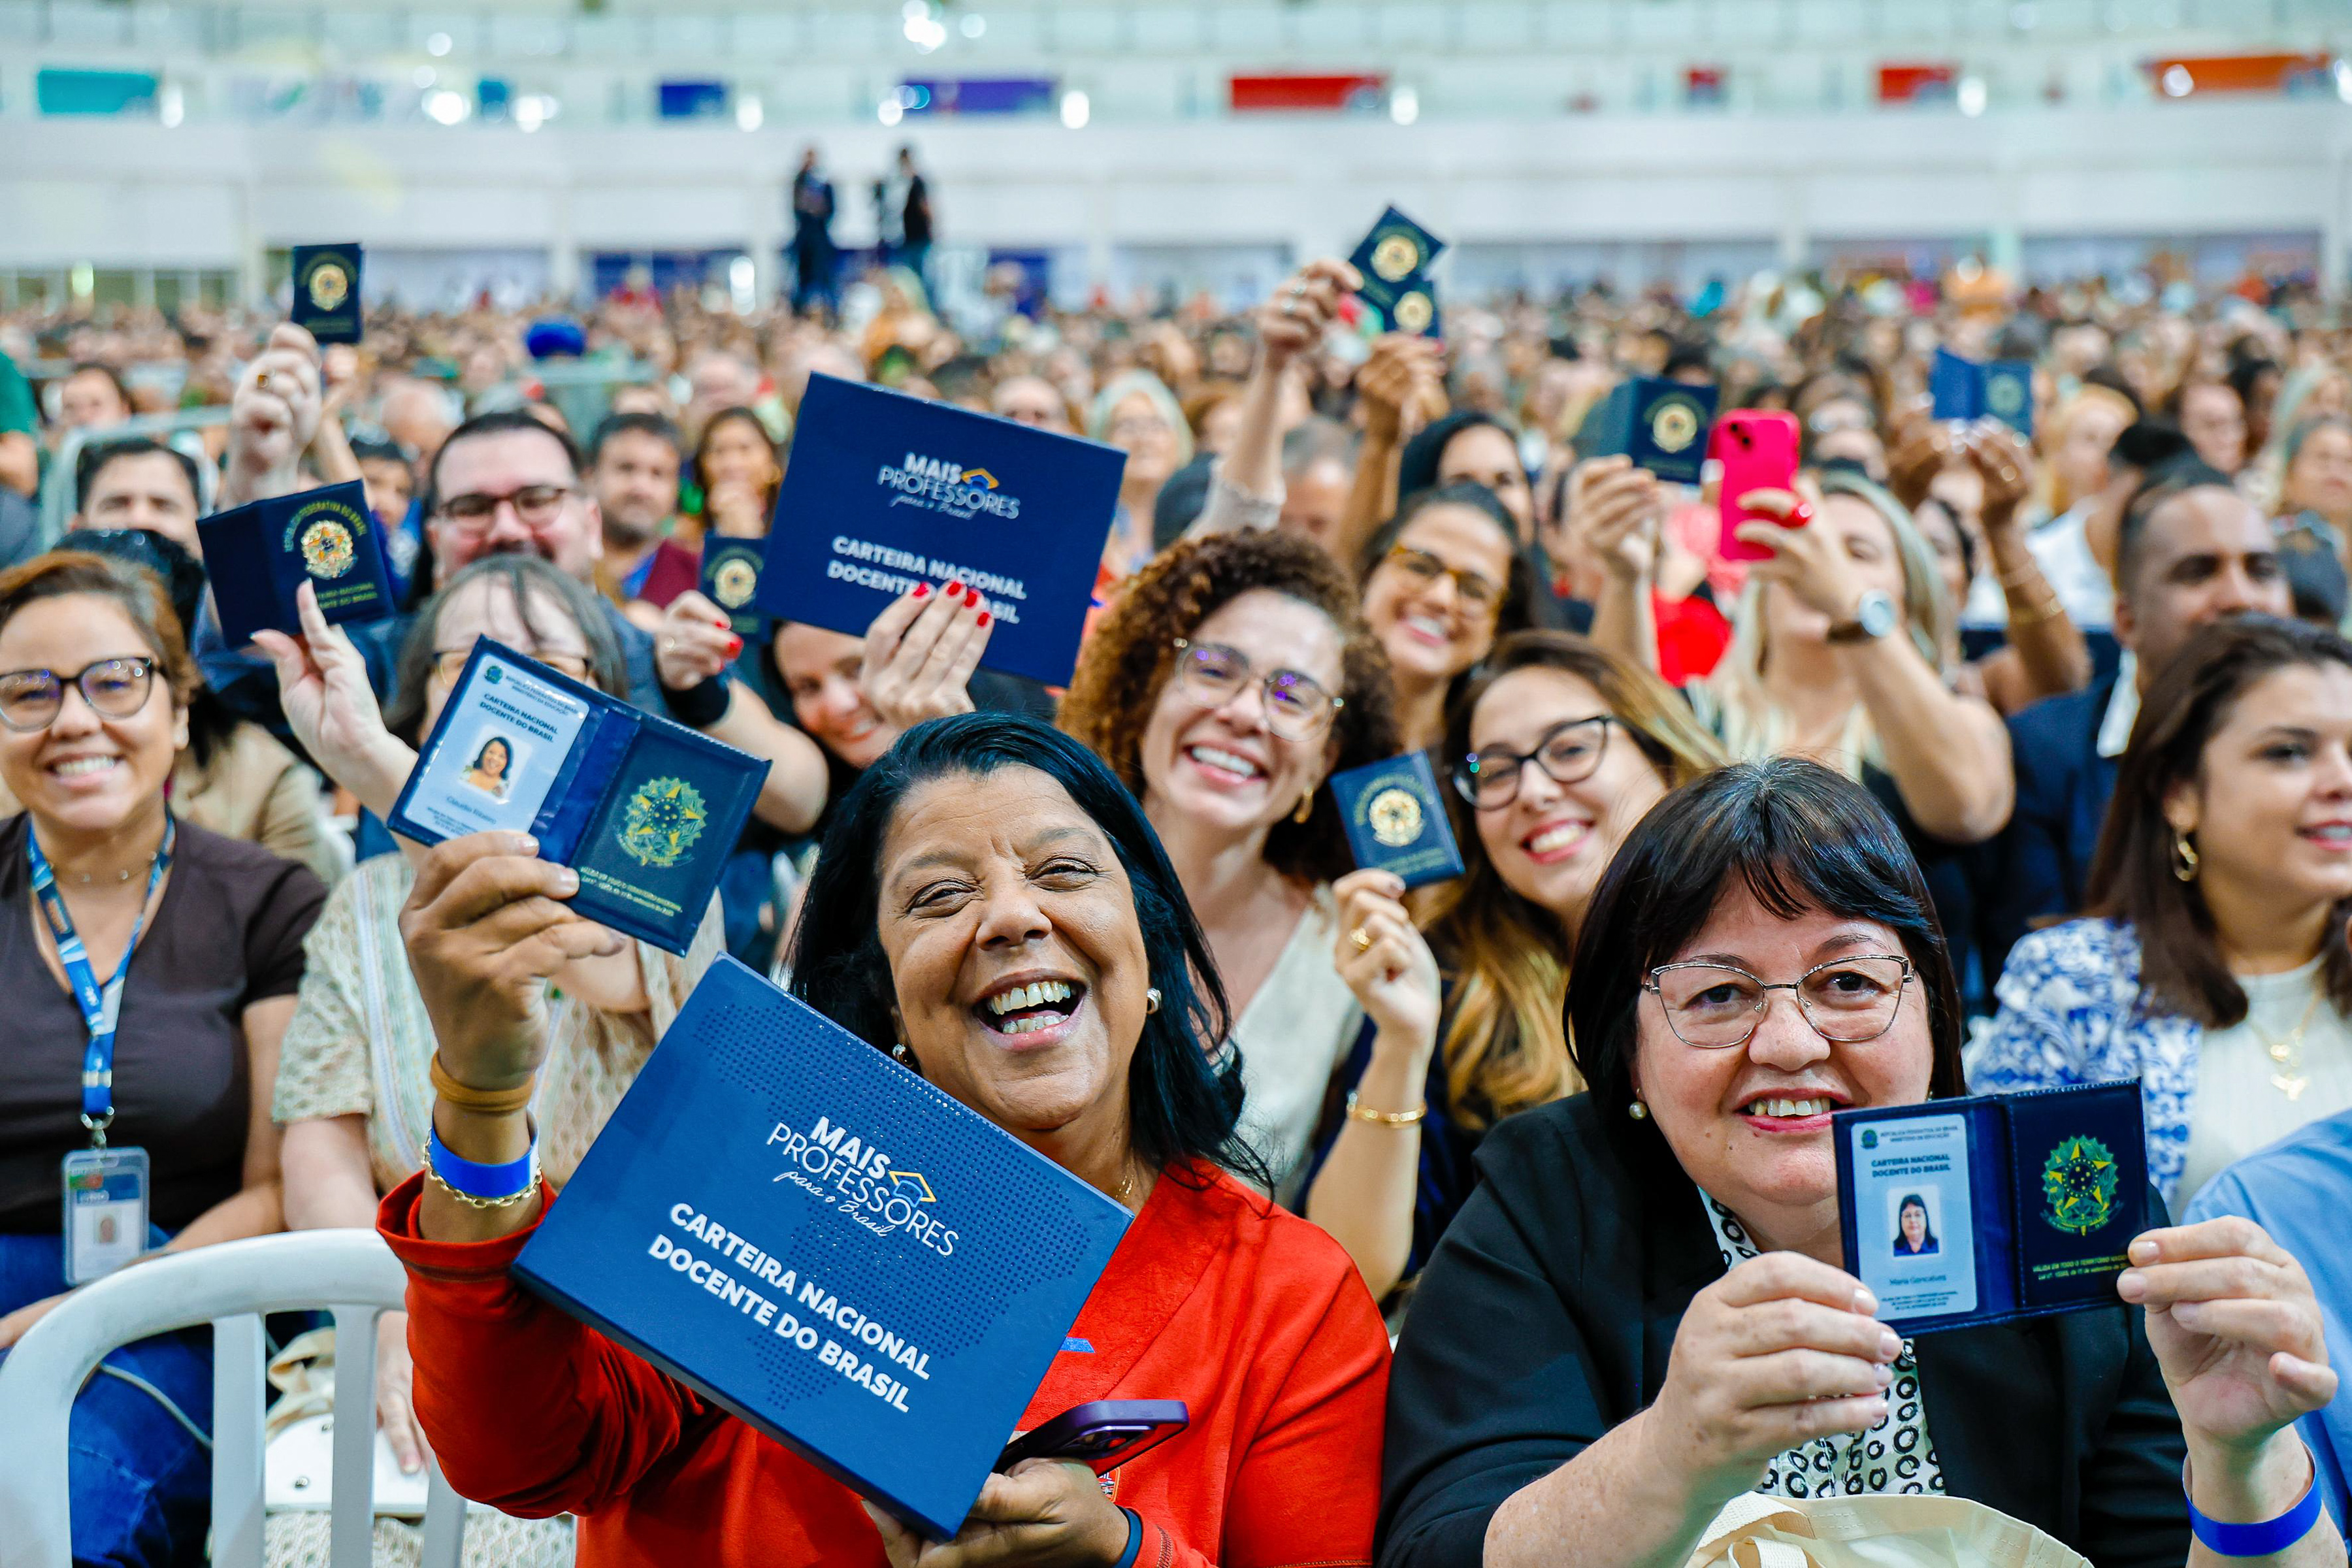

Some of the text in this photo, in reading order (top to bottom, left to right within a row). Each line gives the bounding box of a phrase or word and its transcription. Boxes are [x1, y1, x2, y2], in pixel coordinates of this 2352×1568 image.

[877, 465, 1021, 519] PROFESSORES
[904, 451, 962, 485] MAIS
[832, 535, 1026, 600] CARTEIRA NACIONAL
[480, 702, 553, 743] DOCENTE DO BRASIL
[484, 693, 558, 734] CARTEIRA NACIONAL
[810, 1116, 891, 1179] MAIS
[1871, 1154, 1950, 1168] CARTEIRA NACIONAL
[1872, 1168, 1908, 1178] DOCENTE
[1923, 1164, 1951, 1173] BRASIL
[766, 1122, 959, 1256] PROFESSORES
[774, 1171, 824, 1196] para
[838, 1200, 896, 1237] Brasil
[670, 1203, 932, 1380] CARTEIRA NACIONAL
[648, 1235, 909, 1413] DOCENTE DO BRASIL
